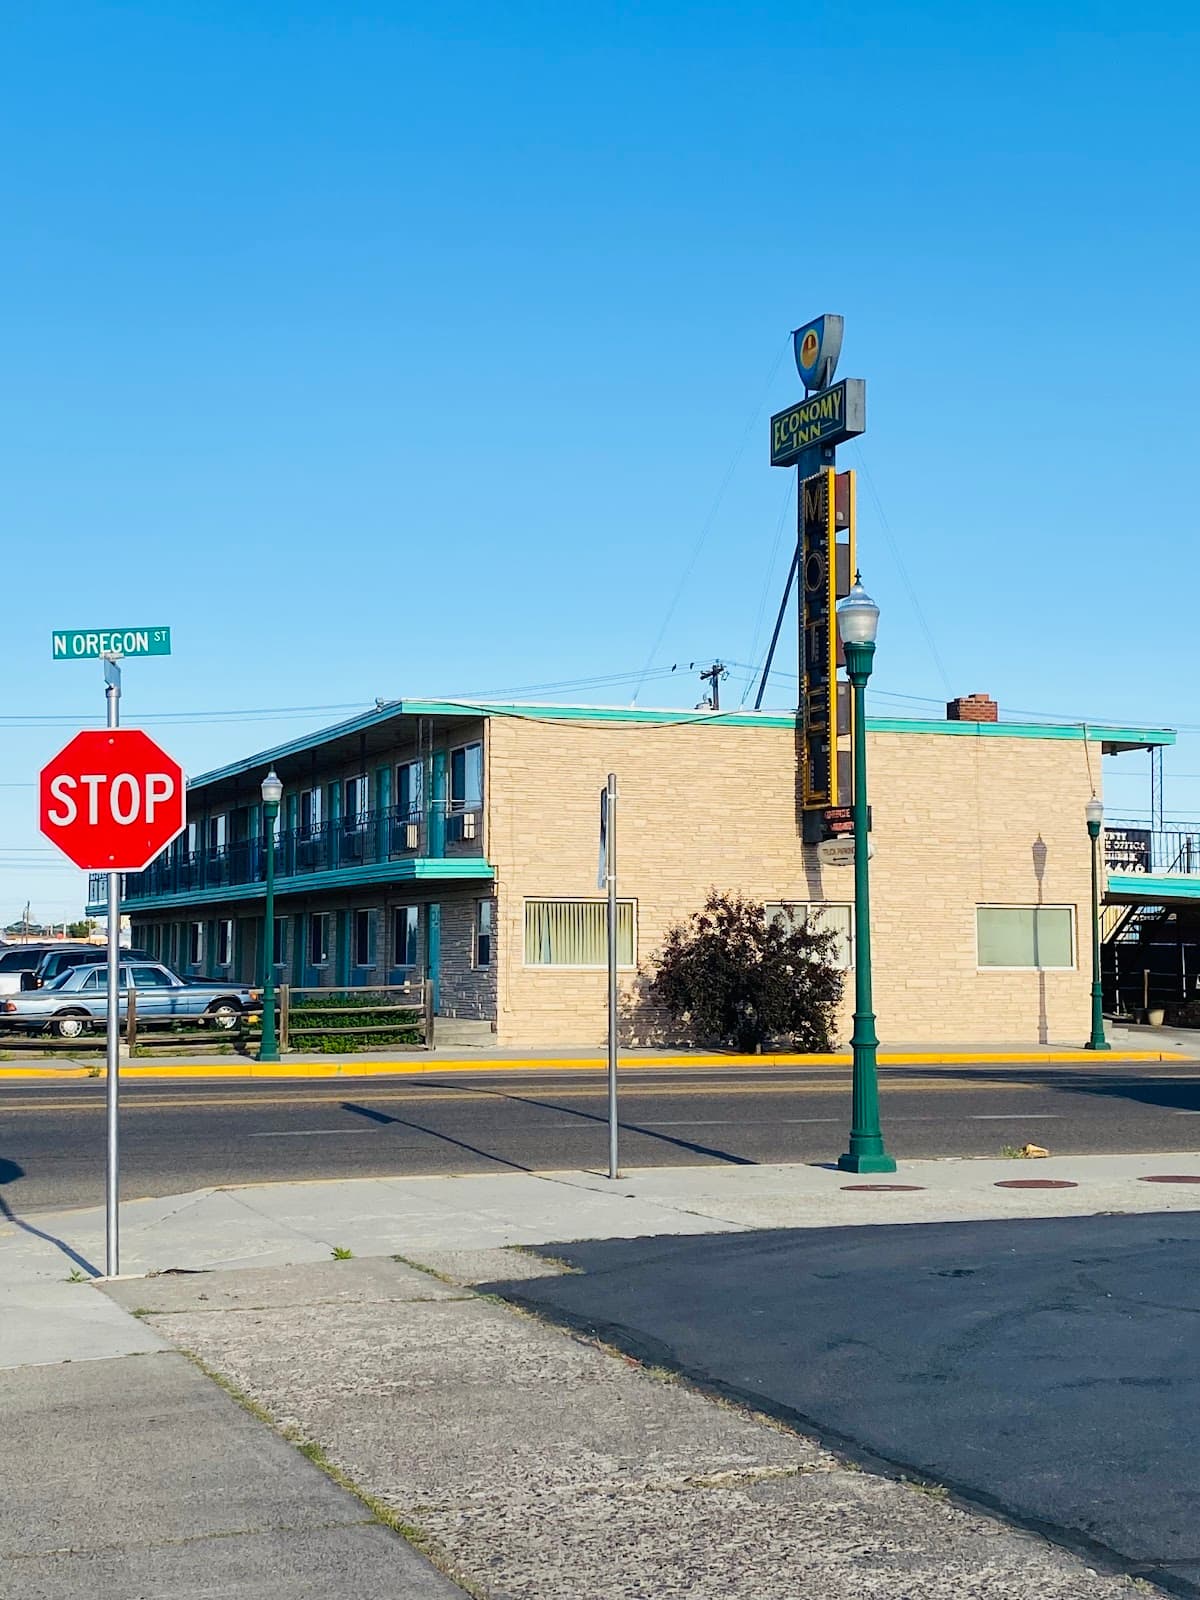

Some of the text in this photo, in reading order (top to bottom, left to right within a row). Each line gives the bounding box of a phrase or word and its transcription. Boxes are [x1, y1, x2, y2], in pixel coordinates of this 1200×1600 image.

[774, 390, 842, 452] ECONOMY
[792, 421, 822, 449] INN
[54, 630, 168, 655] N OREGON ST
[48, 772, 175, 827] STOP
